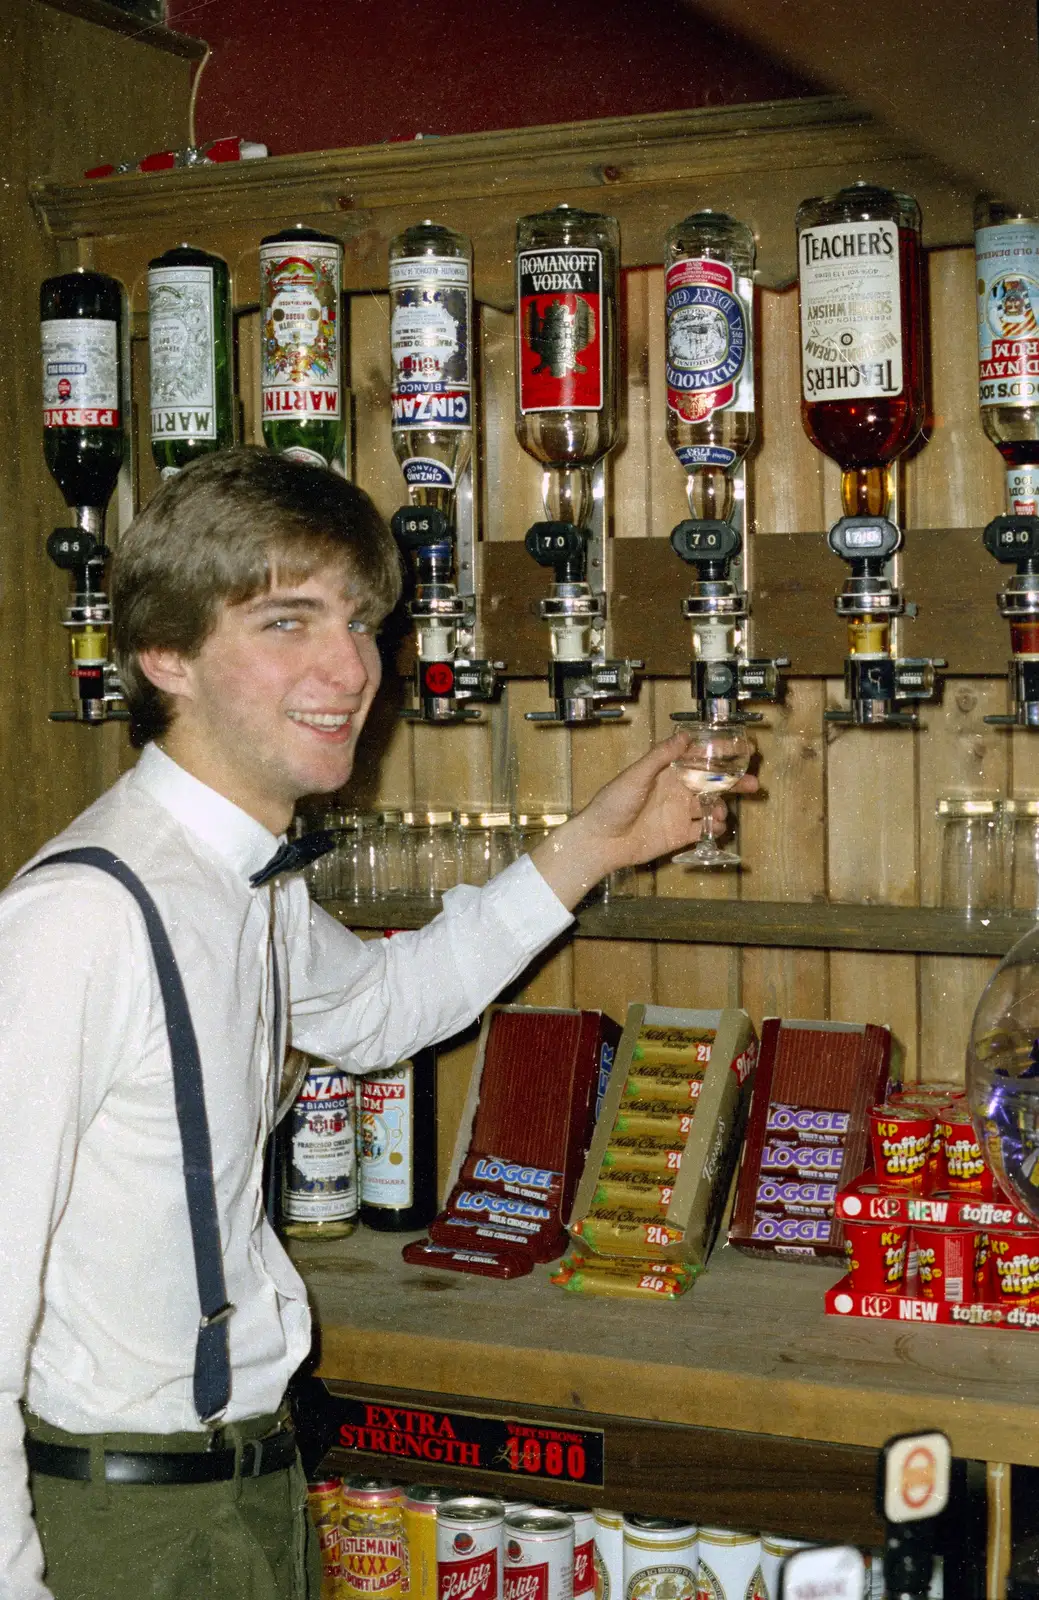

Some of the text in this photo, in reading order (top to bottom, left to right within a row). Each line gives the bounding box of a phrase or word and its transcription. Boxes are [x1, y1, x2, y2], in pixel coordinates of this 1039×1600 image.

[800, 227, 893, 266] TEACHER'S
[521, 254, 597, 275] ROMANOFF
[532, 274, 583, 291] VODKA
[691, 288, 735, 314] DRY
[807, 303, 846, 320] WHISKY
[805, 340, 838, 363] CREAM
[675, 357, 716, 368] ORIGINAL
[979, 361, 1021, 378] NAVY
[400, 383, 442, 393] BIANCO
[807, 360, 899, 396] TEACHER'S
[687, 448, 711, 457] 1793
[407, 472, 443, 481] CINZANO
[364, 1083, 404, 1097] NAVY
[306, 1100, 346, 1110] BIANCO
[877, 1121, 899, 1137] KP
[883, 1133, 931, 1157] toffee
[886, 1152, 926, 1174] dips
[661, 1187, 673, 1204] 2
[870, 1197, 900, 1218] KP
[907, 1200, 948, 1222] NEW
[962, 1204, 1012, 1224] toffee
[647, 1226, 668, 1246] 21p
[991, 1239, 1010, 1255] KP
[861, 1295, 891, 1317] KP
[899, 1299, 939, 1322] NEW
[951, 1304, 1001, 1324] toffee
[364, 1404, 457, 1439] EXTRA
[506, 1423, 583, 1444] VERY STRONG
[339, 1423, 481, 1467] STRENGTH
[506, 1436, 585, 1479] 1080
[349, 1555, 388, 1576] XXXX
[441, 1563, 491, 1600] Schlitz
